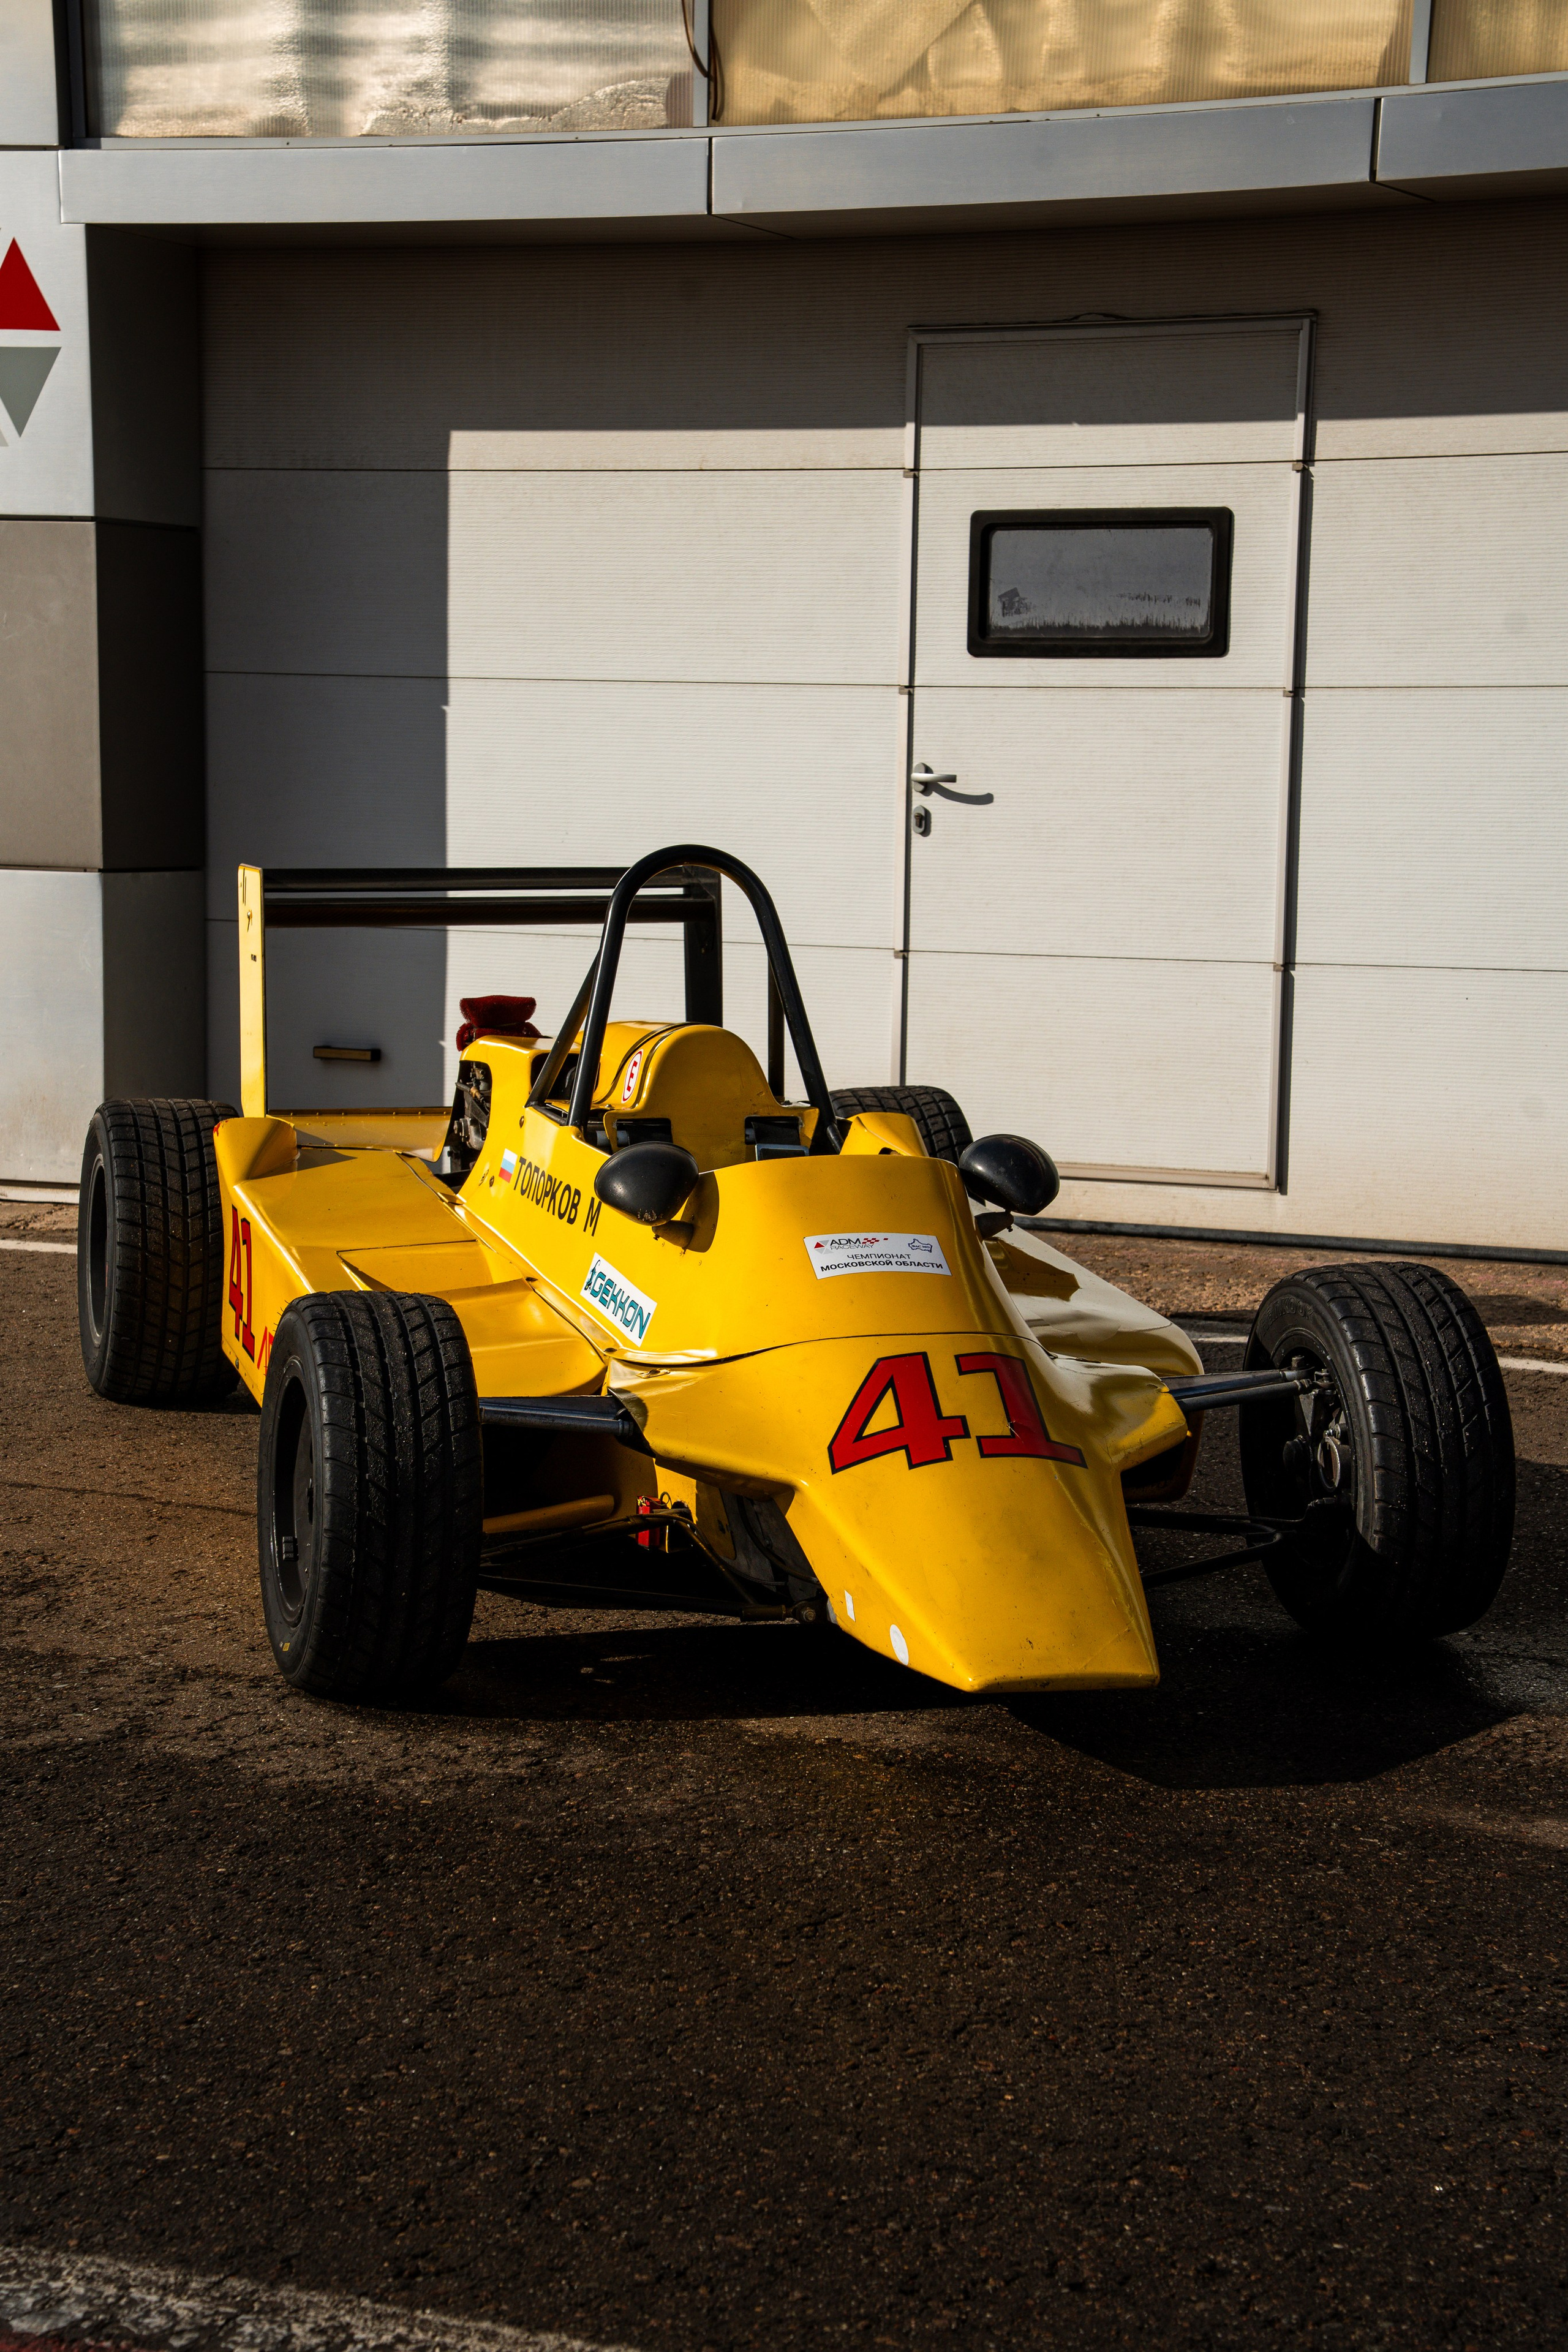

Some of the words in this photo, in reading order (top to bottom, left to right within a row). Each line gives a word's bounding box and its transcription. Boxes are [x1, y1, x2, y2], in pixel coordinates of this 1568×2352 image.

[513, 1156, 581, 1225] ТОПОРКОВ
[583, 1197, 602, 1237] М
[228, 1204, 255, 1363] 41
[590, 1271, 651, 1340] GEKKON
[821, 1259, 893, 1272] МОСКОВСКОЙ
[827, 1351, 1088, 1475] 41
